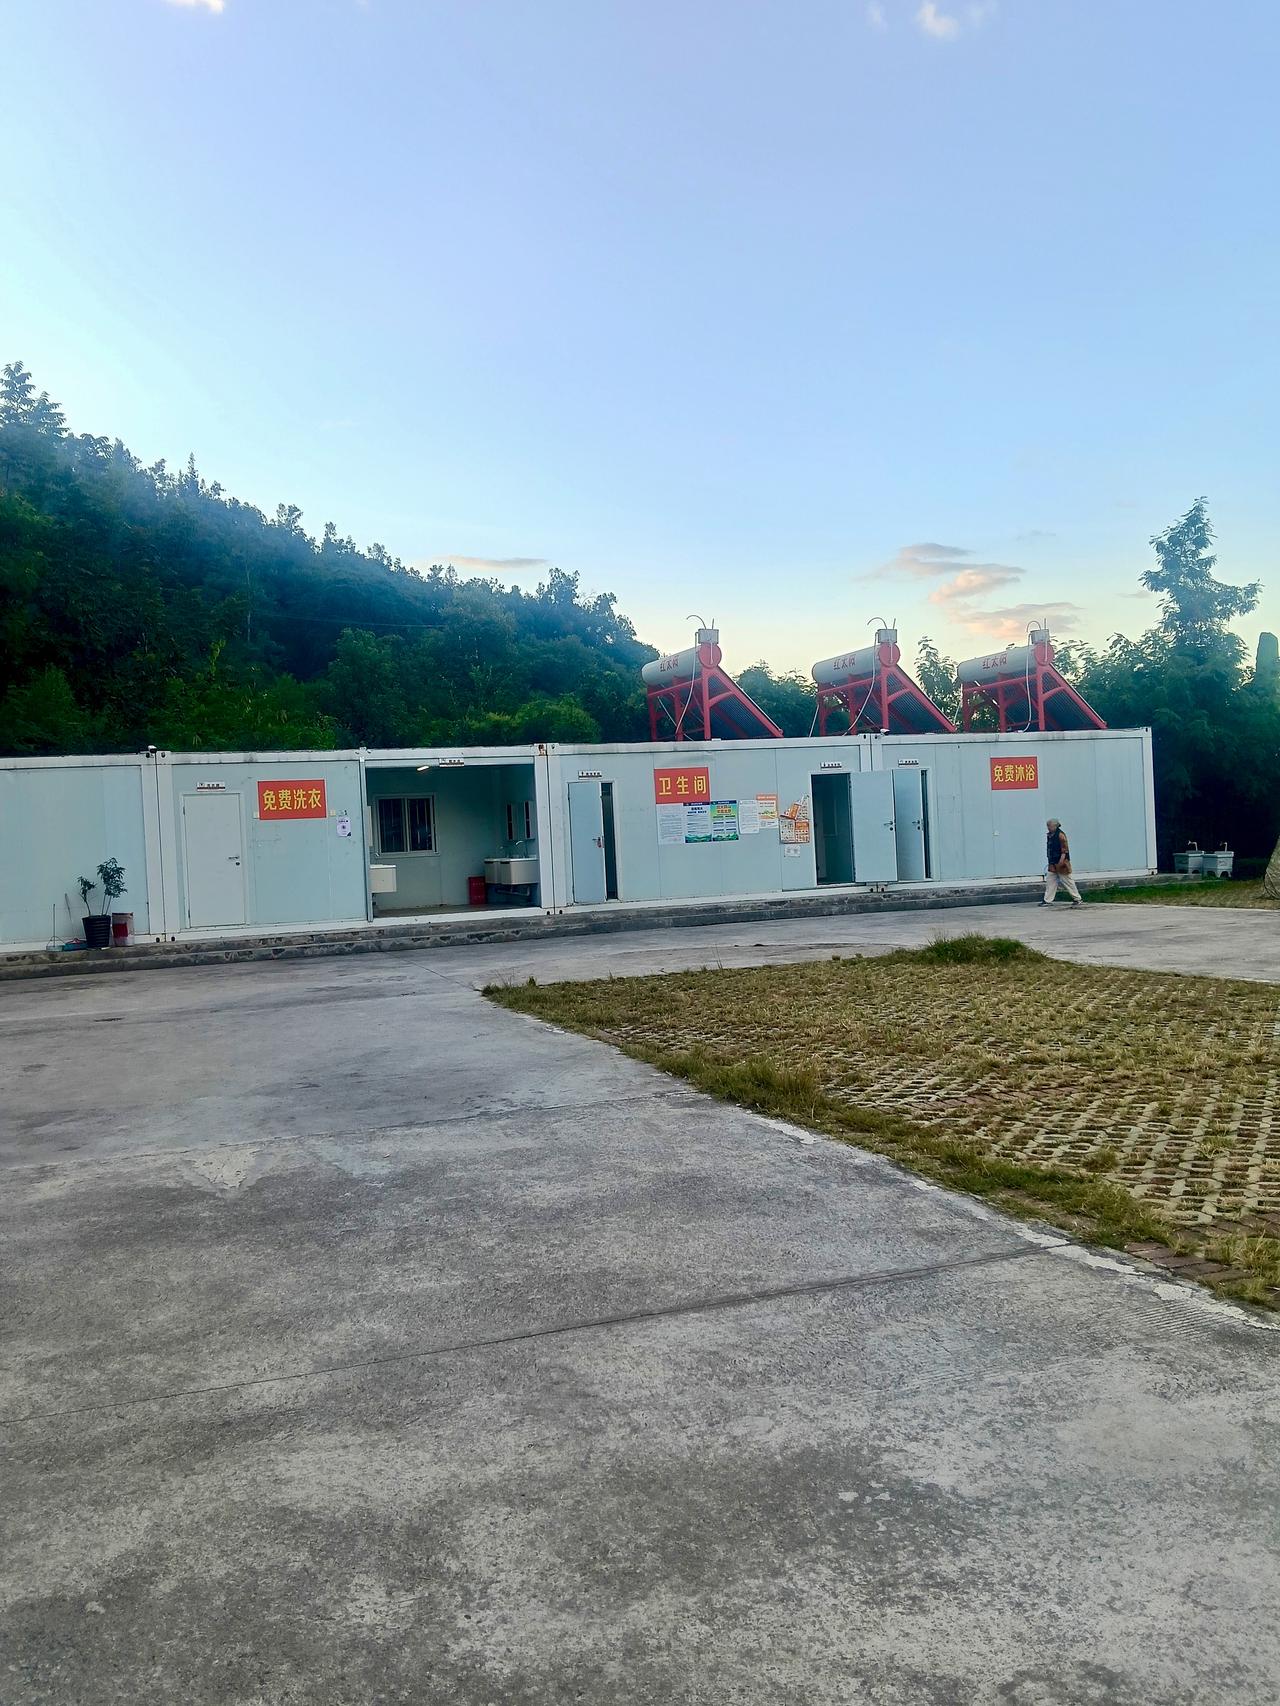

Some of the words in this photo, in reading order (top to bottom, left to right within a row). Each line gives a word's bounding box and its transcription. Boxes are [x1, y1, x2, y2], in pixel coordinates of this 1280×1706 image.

[993, 764, 1035, 782] 免费沐浴
[658, 775, 707, 795] 卫生间
[263, 788, 322, 811] 免费洗衣
